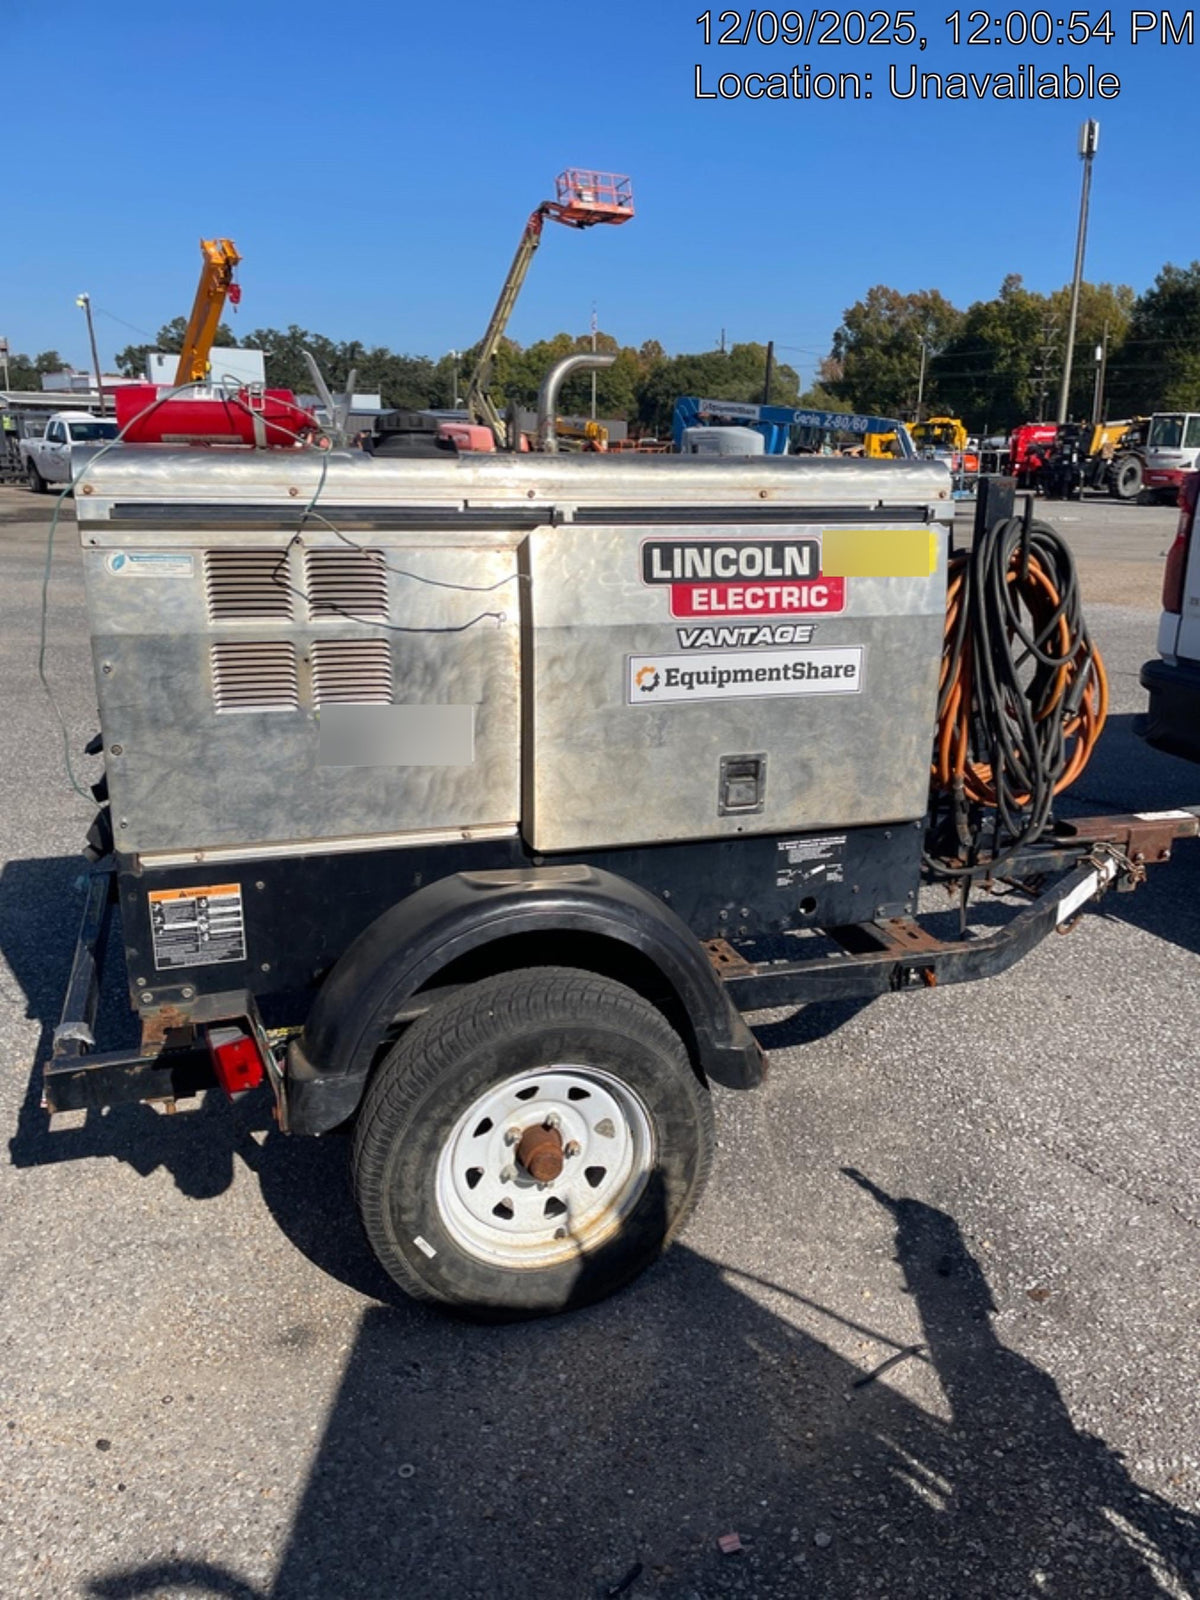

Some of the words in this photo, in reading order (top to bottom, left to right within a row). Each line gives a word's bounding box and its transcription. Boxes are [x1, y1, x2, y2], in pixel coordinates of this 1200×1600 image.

[793, 411, 821, 426] Genie
[651, 546, 811, 578] LINCOLN
[691, 585, 829, 611] ELECTRIC
[677, 624, 813, 649] VANTAGE
[664, 662, 856, 690] EquipmentShare
